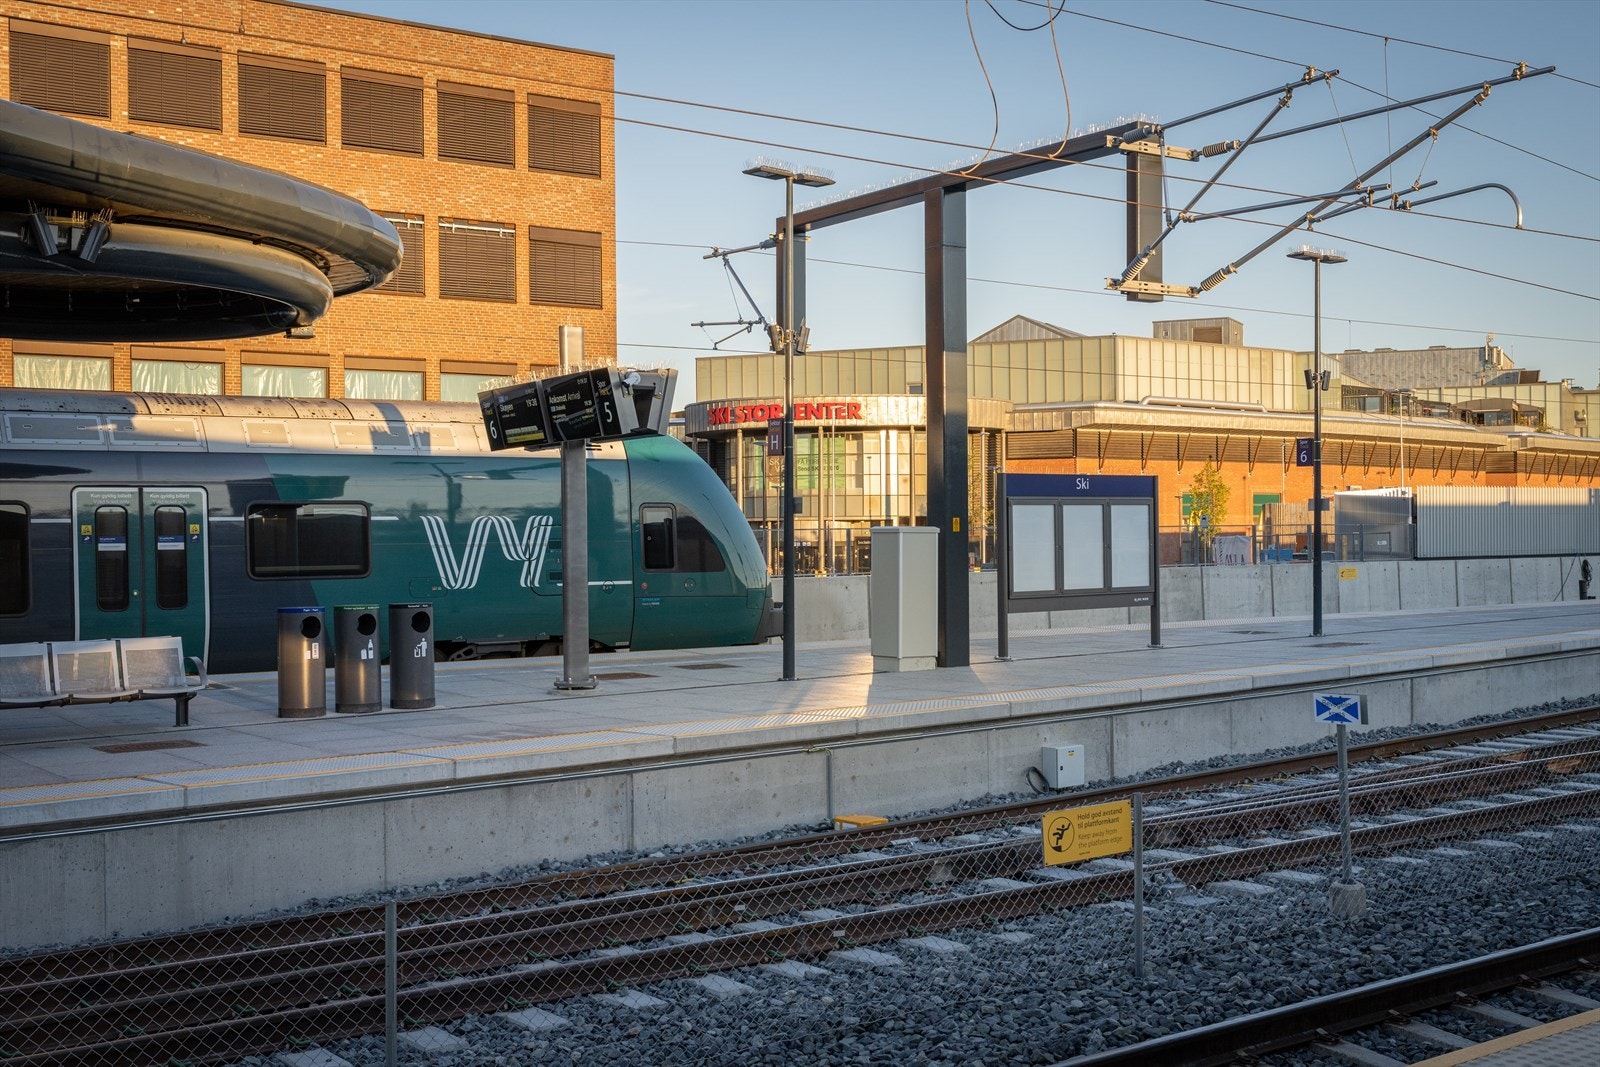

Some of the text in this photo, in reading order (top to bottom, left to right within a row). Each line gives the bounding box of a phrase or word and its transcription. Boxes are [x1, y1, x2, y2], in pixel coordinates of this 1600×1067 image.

[597, 380, 606, 388] Spor
[549, 391, 581, 404] Ankomst Arrival
[604, 401, 613, 423] 5
[708, 402, 862, 425] SKI STORENTER
[490, 420, 498, 439] 6
[771, 434, 779, 450] H
[1300, 450, 1308, 462] 6
[1076, 477, 1089, 490] Ski
[1091, 811, 1101, 819] god
[1103, 808, 1122, 816] avstand
[1084, 817, 1119, 829] plattformkant
[1078, 836, 1122, 849] the platform edge
